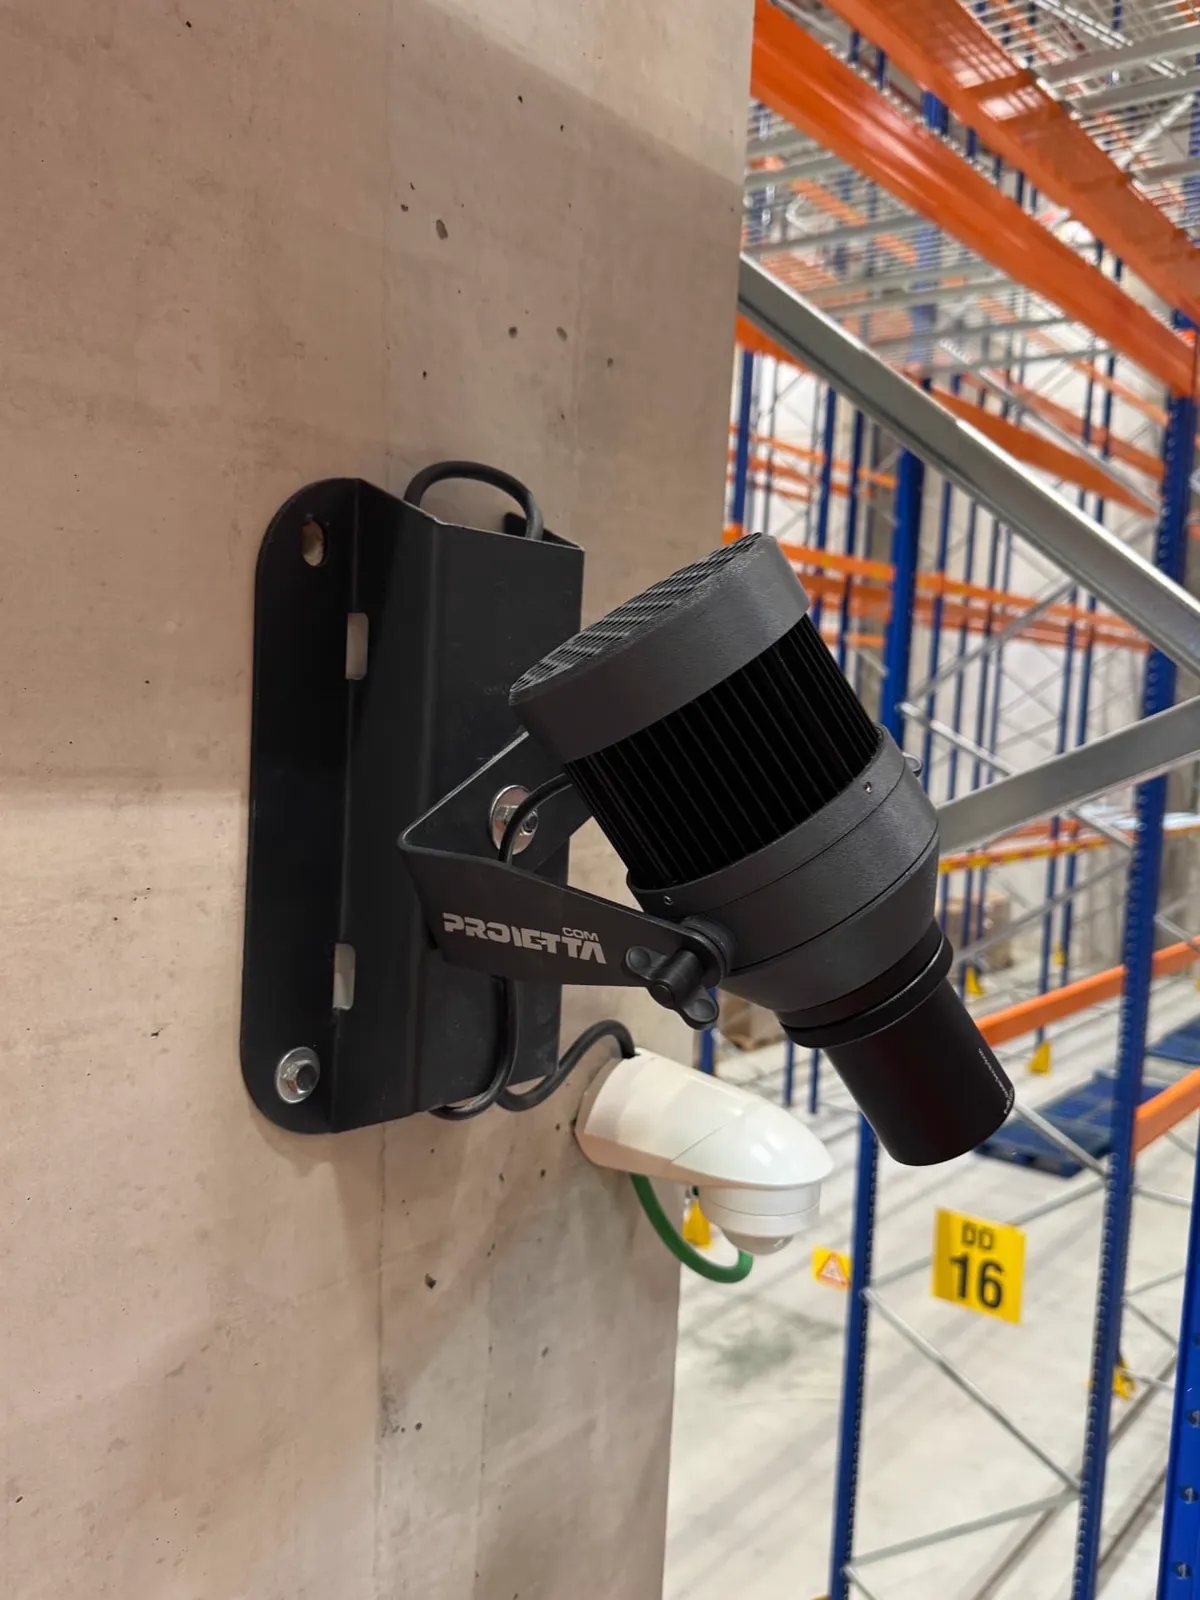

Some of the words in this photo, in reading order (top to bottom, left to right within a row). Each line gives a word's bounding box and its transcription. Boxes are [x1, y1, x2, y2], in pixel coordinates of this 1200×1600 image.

[443, 912, 607, 964] PROIETTA
[561, 927, 599, 942] COM
[949, 1252, 1005, 1309] 16
